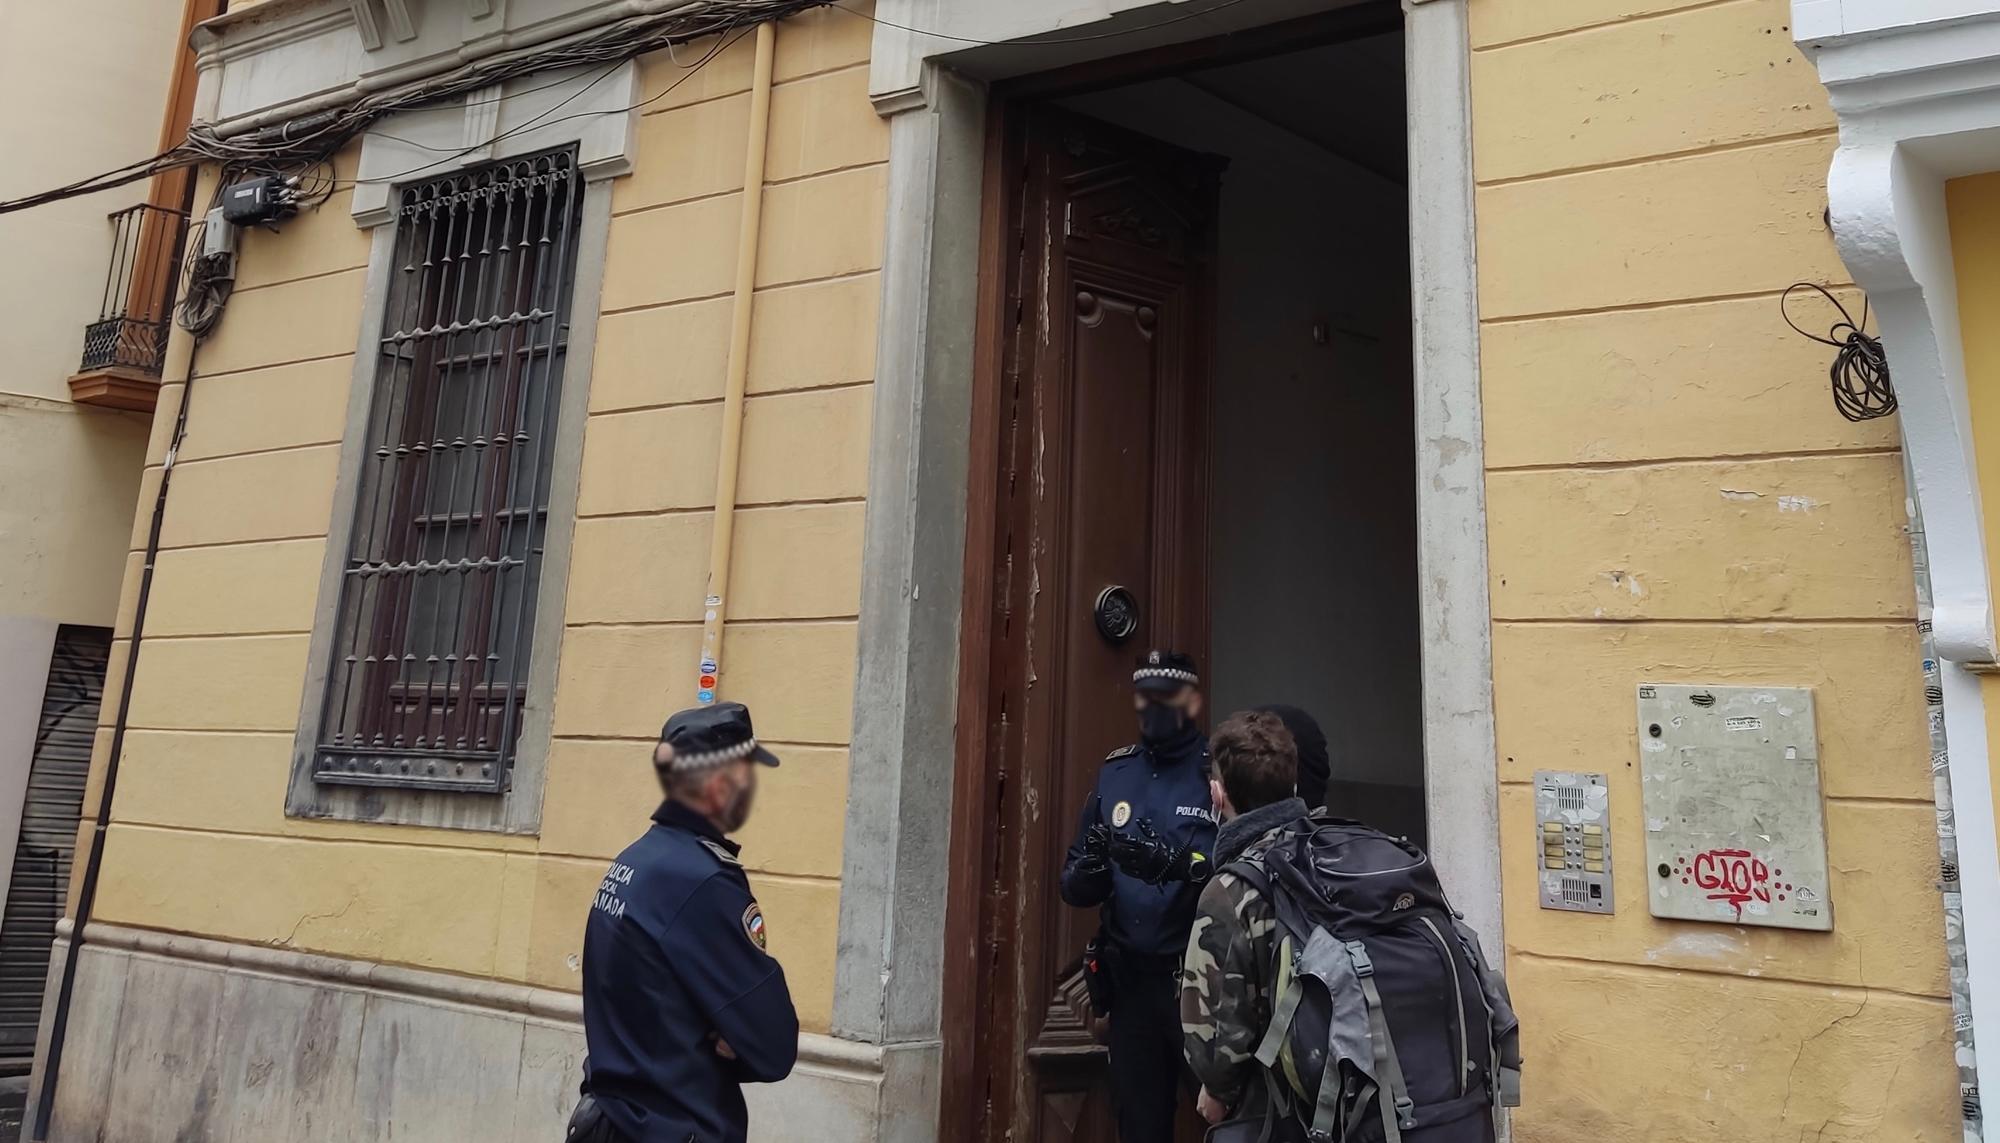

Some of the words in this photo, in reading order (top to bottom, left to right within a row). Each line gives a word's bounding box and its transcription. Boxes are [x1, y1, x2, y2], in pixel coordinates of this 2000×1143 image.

[608, 862, 634, 885] LICIA
[602, 880, 618, 894] OCAL
[594, 891, 626, 919] ANADA
